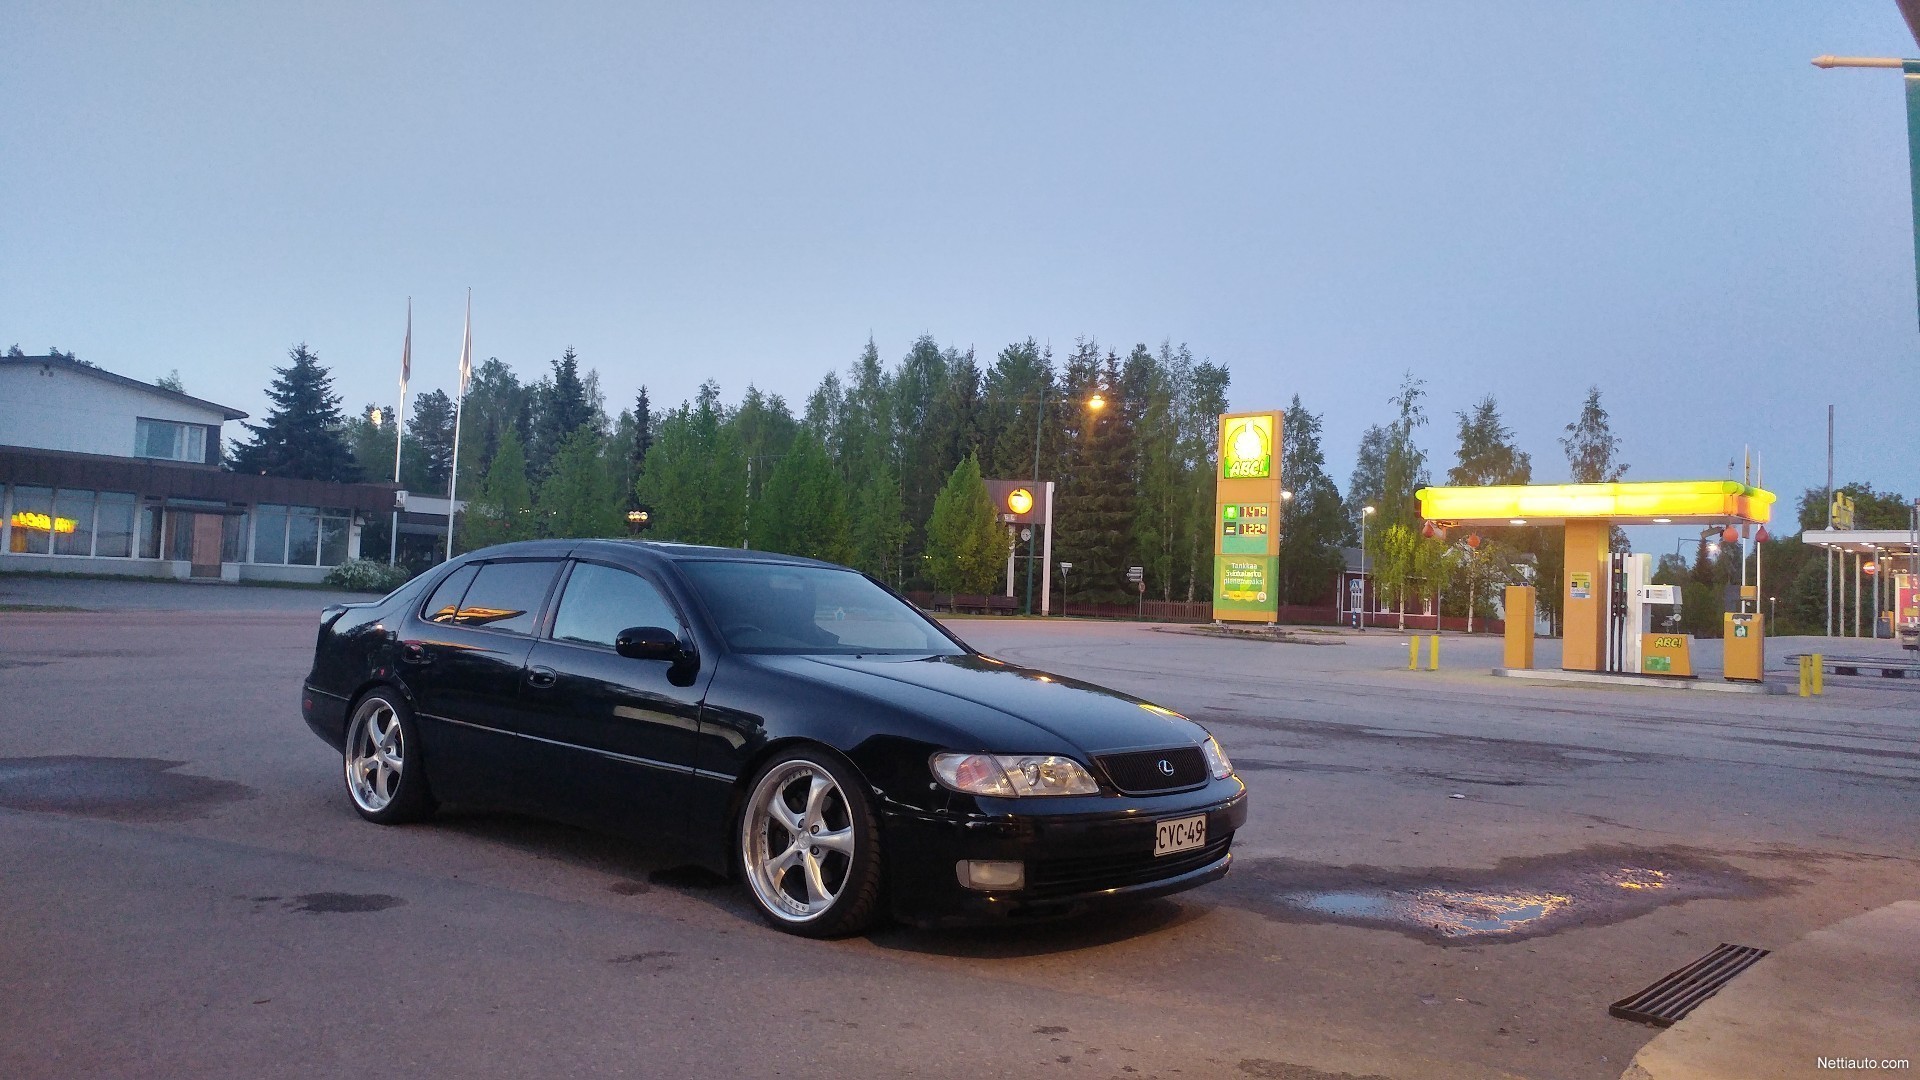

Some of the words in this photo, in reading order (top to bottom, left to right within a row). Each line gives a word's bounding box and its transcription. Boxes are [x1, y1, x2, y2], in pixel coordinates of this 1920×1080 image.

[1230, 460, 1265, 477] ABC!
[1636, 589, 1642, 597] 2
[1655, 637, 1682, 648] ABC!
[1159, 820, 1204, 849] CVC-49
